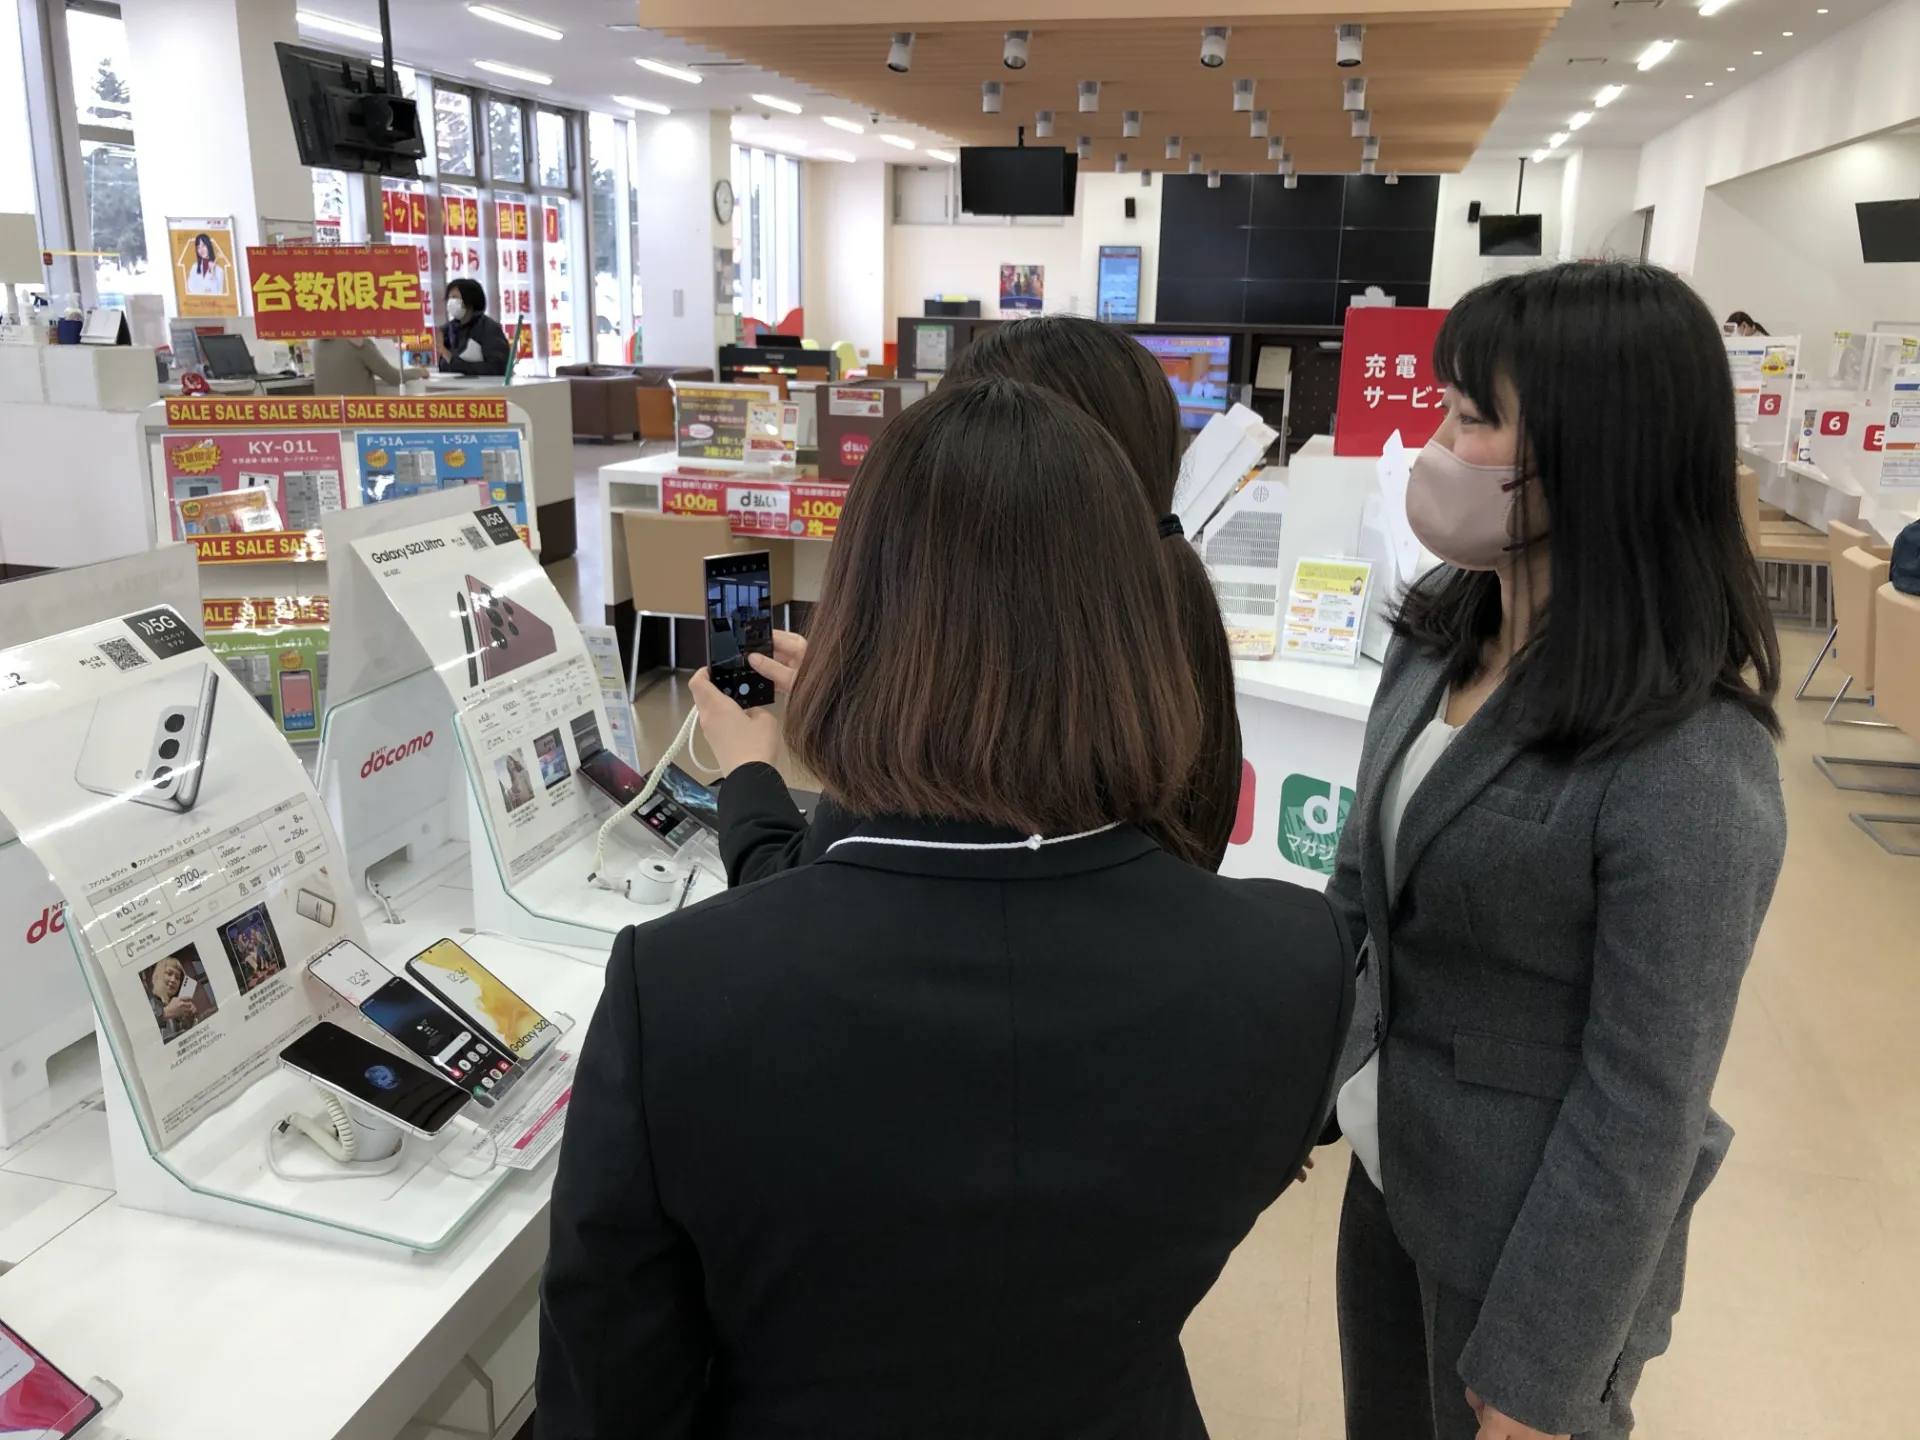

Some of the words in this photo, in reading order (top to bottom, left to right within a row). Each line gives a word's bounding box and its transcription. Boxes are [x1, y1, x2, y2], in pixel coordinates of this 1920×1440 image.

[253, 270, 421, 312] 台数限定
[1364, 353, 1417, 378] 充電
[170, 404, 211, 421] SALE
[215, 404, 255, 421] SALE
[259, 404, 298, 420] SALE
[302, 403, 340, 420] SALE
[347, 403, 385, 419] SALE
[389, 403, 425, 419] SALE
[429, 403, 466, 418] SALE
[469, 403, 505, 418] SALE
[1764, 397, 1775, 411] 6
[1828, 416, 1841, 431] 6
[366, 436, 404, 447] F-51A
[442, 434, 478, 445] L-52A
[1872, 431, 1884, 446] 5
[248, 440, 318, 454] KY-01L
[740, 492, 777, 508] d払い
[236, 538, 274, 555] SALE
[371, 547, 409, 564] Galaxy
[405, 542, 424, 556] S22
[422, 537, 446, 552] Ultra
[149, 615, 177, 632] 5G
[361, 730, 434, 778] docomo
[376, 745, 387, 755] NTT
[510, 1030, 539, 1052] Galaxy
[534, 1019, 550, 1033] S22
